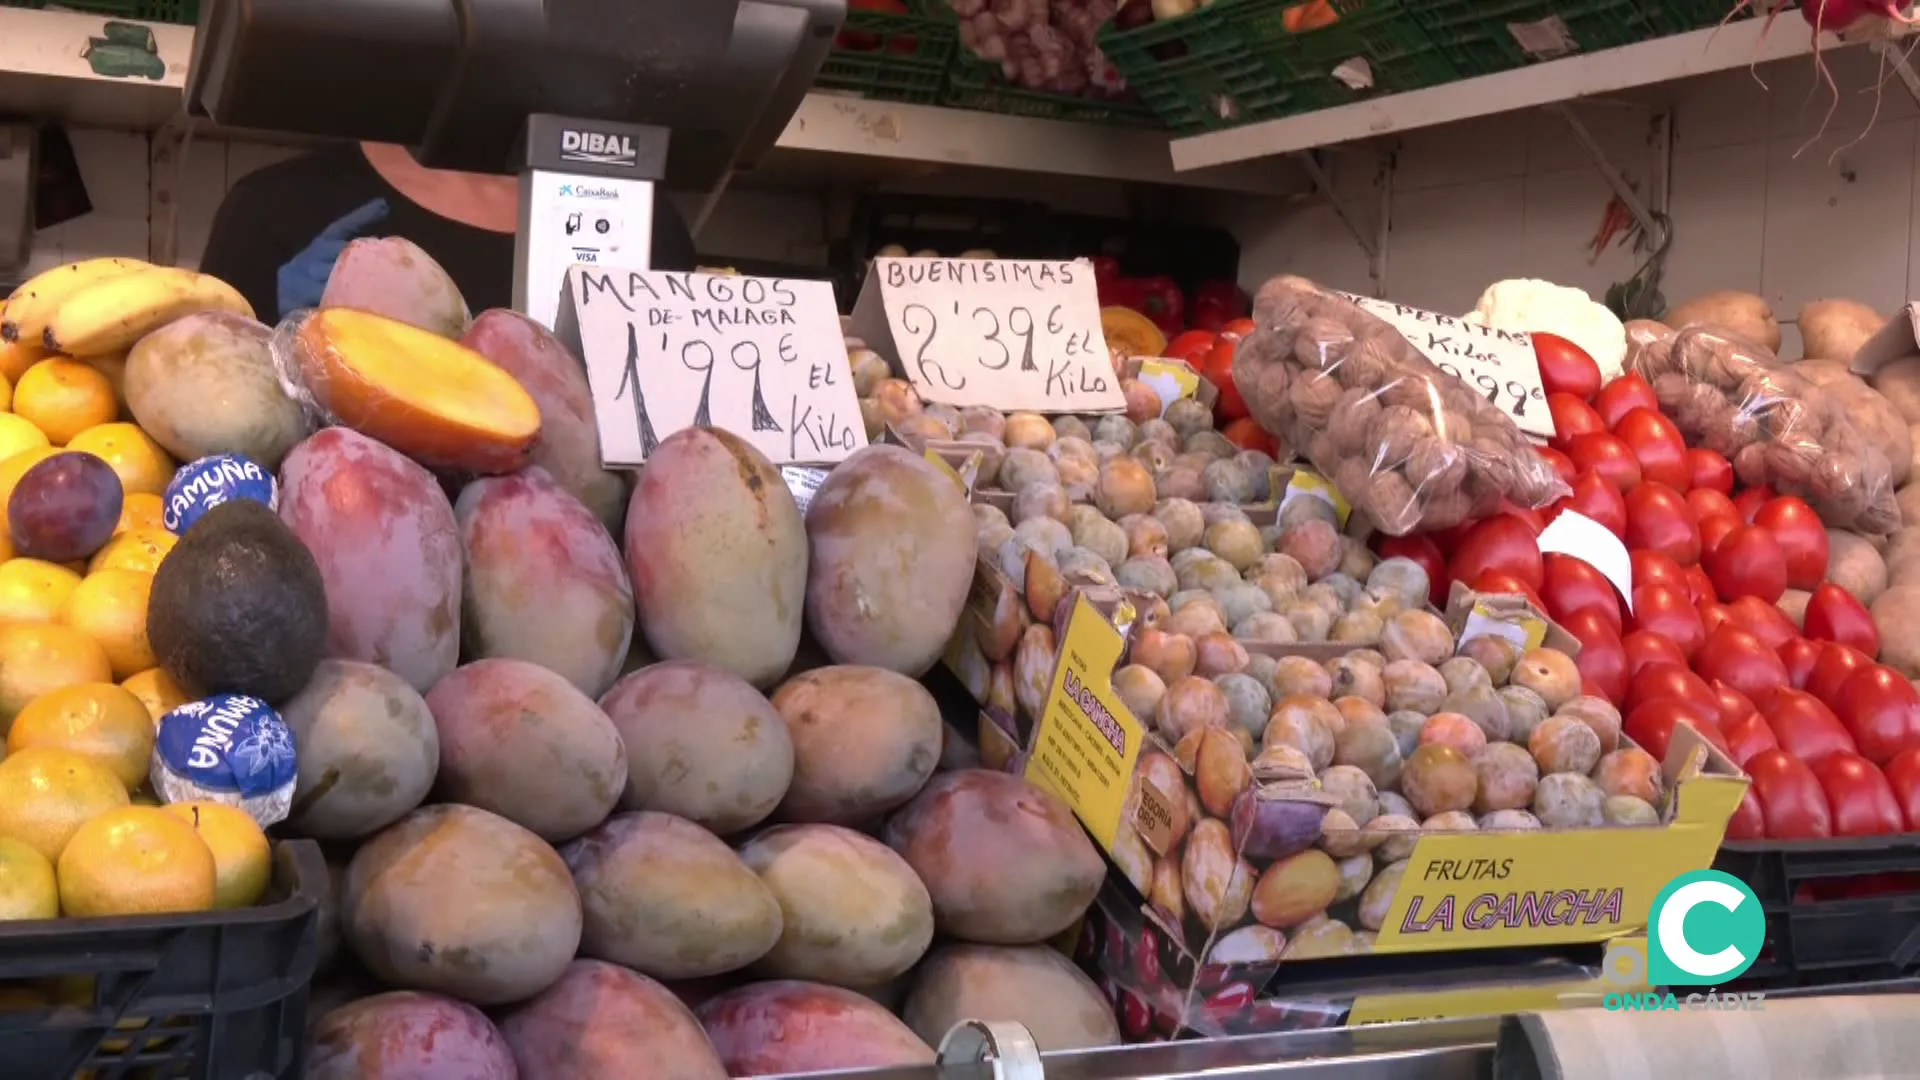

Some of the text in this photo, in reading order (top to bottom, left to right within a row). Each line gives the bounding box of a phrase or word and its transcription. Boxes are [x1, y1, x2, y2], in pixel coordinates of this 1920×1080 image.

[562, 130, 637, 157] DIBAL
[576, 252, 597, 263] VISA
[887, 260, 1074, 291] BUENISIMAS
[581, 270, 797, 312] MANGOS
[692, 308, 797, 334] MALAGA
[1065, 330, 1095, 356] EL
[809, 363, 837, 390] EL
[163, 457, 263, 531] CAMUÑA
[1062, 667, 1080, 705] LA
[1078, 687, 1126, 759] CANCHA
[187, 696, 260, 769] AMUÑA
[1423, 858, 1514, 881] FRUTAS
[1399, 886, 1625, 934] LA CANCHA
